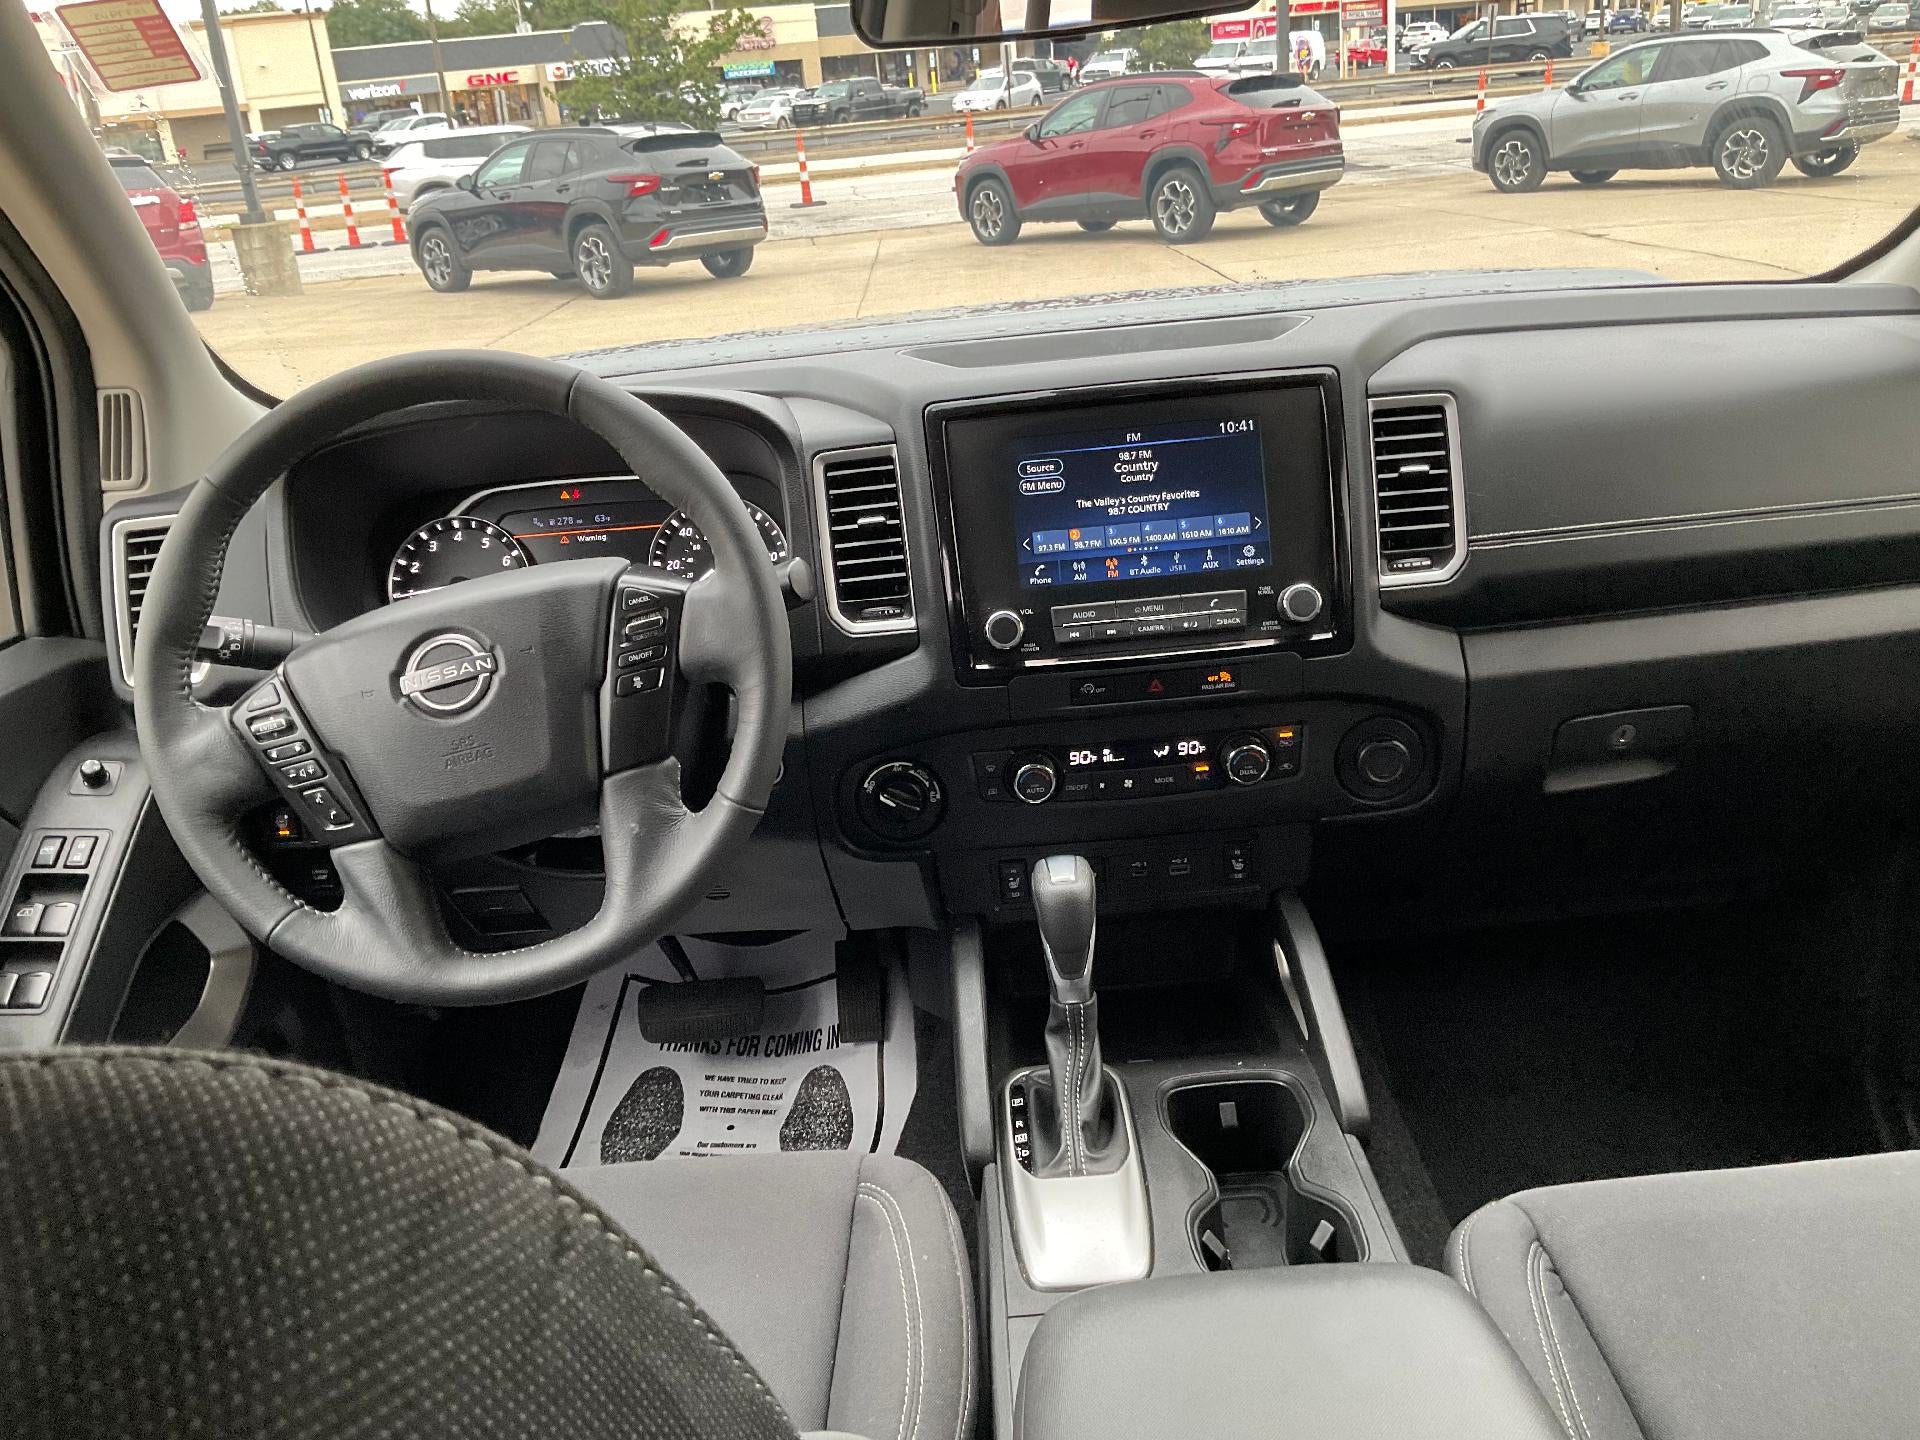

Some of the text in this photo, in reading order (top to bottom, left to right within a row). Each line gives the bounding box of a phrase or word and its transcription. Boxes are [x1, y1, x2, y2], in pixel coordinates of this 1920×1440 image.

[466, 70, 519, 88] GNC
[348, 82, 401, 100] verizon
[1219, 419, 1254, 434] 10:41
[1126, 433, 1141, 442] FM
[1118, 450, 1152, 461] 98.7 FM
[1026, 462, 1055, 474] Source
[1114, 460, 1159, 474] Country
[1120, 473, 1154, 483] Country
[1022, 480, 1062, 492] FM Menu
[1076, 490, 1200, 509] The Valley's Country Favorites
[1108, 502, 1170, 516] 98.7 COUNTRY
[557, 516, 574, 526] 278
[678, 527, 692, 537] 40
[1200, 530, 1212, 538] AM
[1236, 526, 1249, 534] AM
[454, 531, 462, 542] 4
[577, 534, 607, 542] Warning
[1129, 536, 1140, 544] FM
[1162, 532, 1176, 541] AM
[428, 540, 437, 552] 3
[481, 538, 490, 548] 5
[1054, 543, 1066, 552] FM
[1090, 540, 1101, 548] FM
[502, 556, 510, 566] 6
[666, 560, 680, 570] 20
[1202, 560, 1218, 569] AUX
[1236, 556, 1264, 567] Settings
[410, 562, 420, 573] 2
[1129, 566, 1162, 576] BT Audio
[1074, 572, 1086, 581] AM
[1107, 569, 1119, 578] FM
[1030, 576, 1052, 585] Phone
[628, 595, 650, 606] CANCEL
[1020, 608, 1034, 616] VOL
[1142, 604, 1164, 613] MENU
[1072, 610, 1096, 620] AUDIO
[628, 650, 652, 662] ON/OFF
[404, 657, 492, 690] NISSAN
[444, 747, 496, 770] AIRBAG
[1154, 776, 1174, 784] MODE
[726, 1035, 760, 1058] FOR
[764, 1028, 823, 1058] COMING
[826, 1023, 840, 1050] IN
[700, 1090, 720, 1098] YOUR
[720, 1091, 760, 1100] CARPETING
[720, 1106, 736, 1114] THIS
[1015, 1120, 1024, 1128] R
